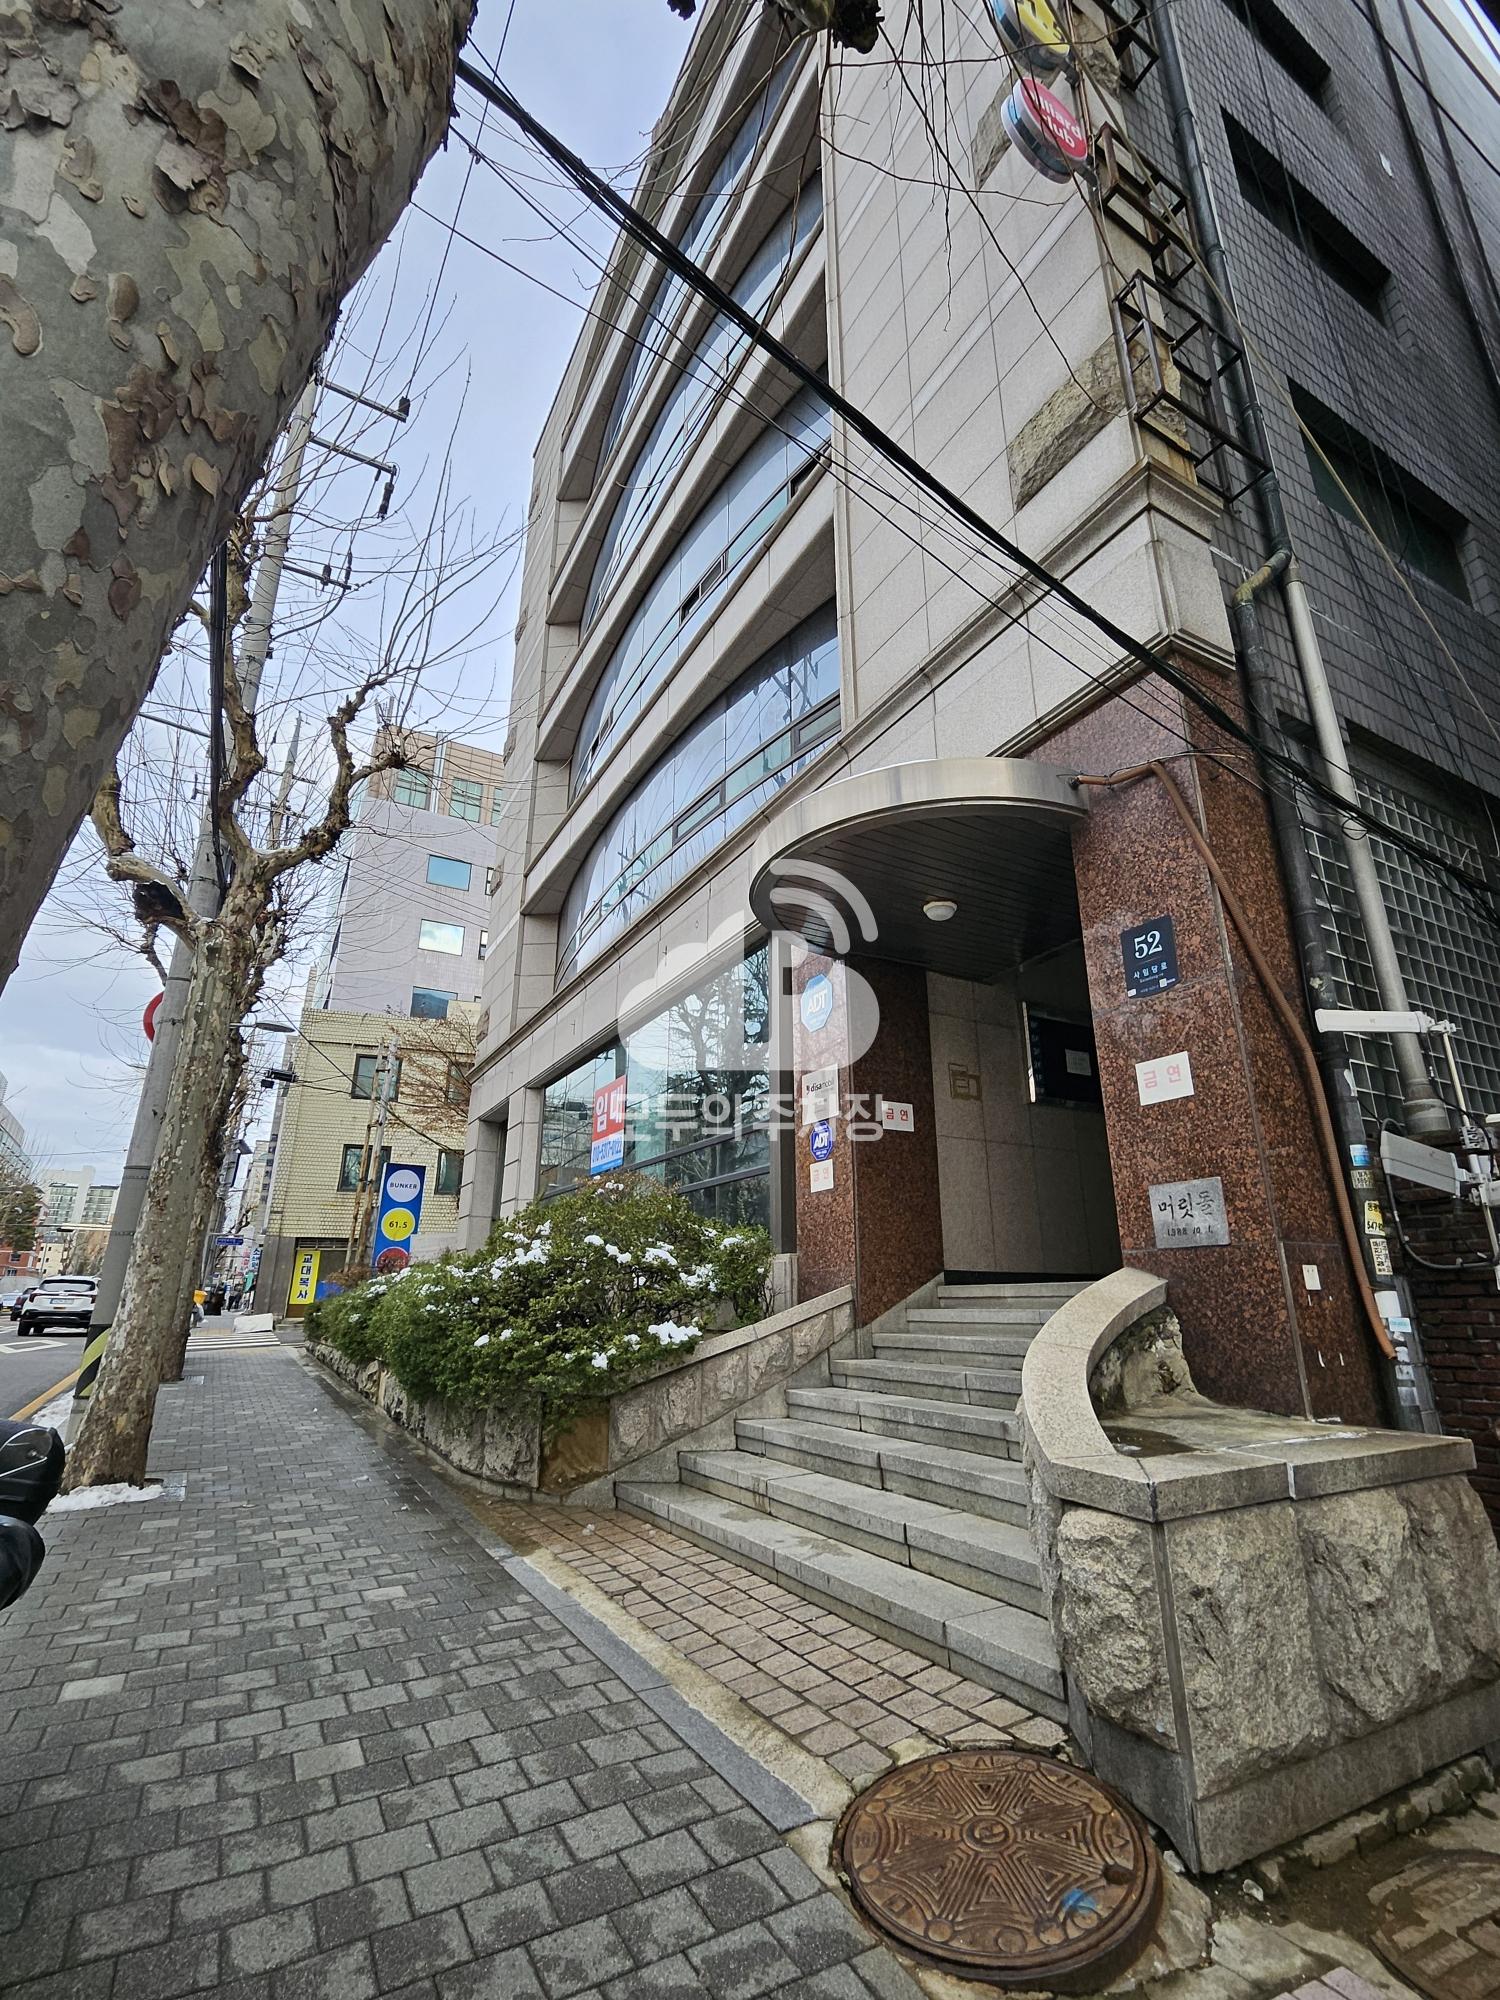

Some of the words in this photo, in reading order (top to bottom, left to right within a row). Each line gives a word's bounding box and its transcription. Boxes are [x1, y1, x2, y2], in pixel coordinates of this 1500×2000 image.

[1134, 930, 1163, 959] 52
[1133, 961, 1168, 979] 사임당로
[806, 989, 828, 1017] ADT
[1143, 1063, 1182, 1089] 금연
[596, 1085, 624, 1133] 임대
[885, 1107, 909, 1122] 금연
[813, 1132, 829, 1150] ADT
[389, 1181, 418, 1190] BUNKER
[1158, 1190, 1215, 1220] 머릿돌
[388, 1220, 409, 1229] 61.5
